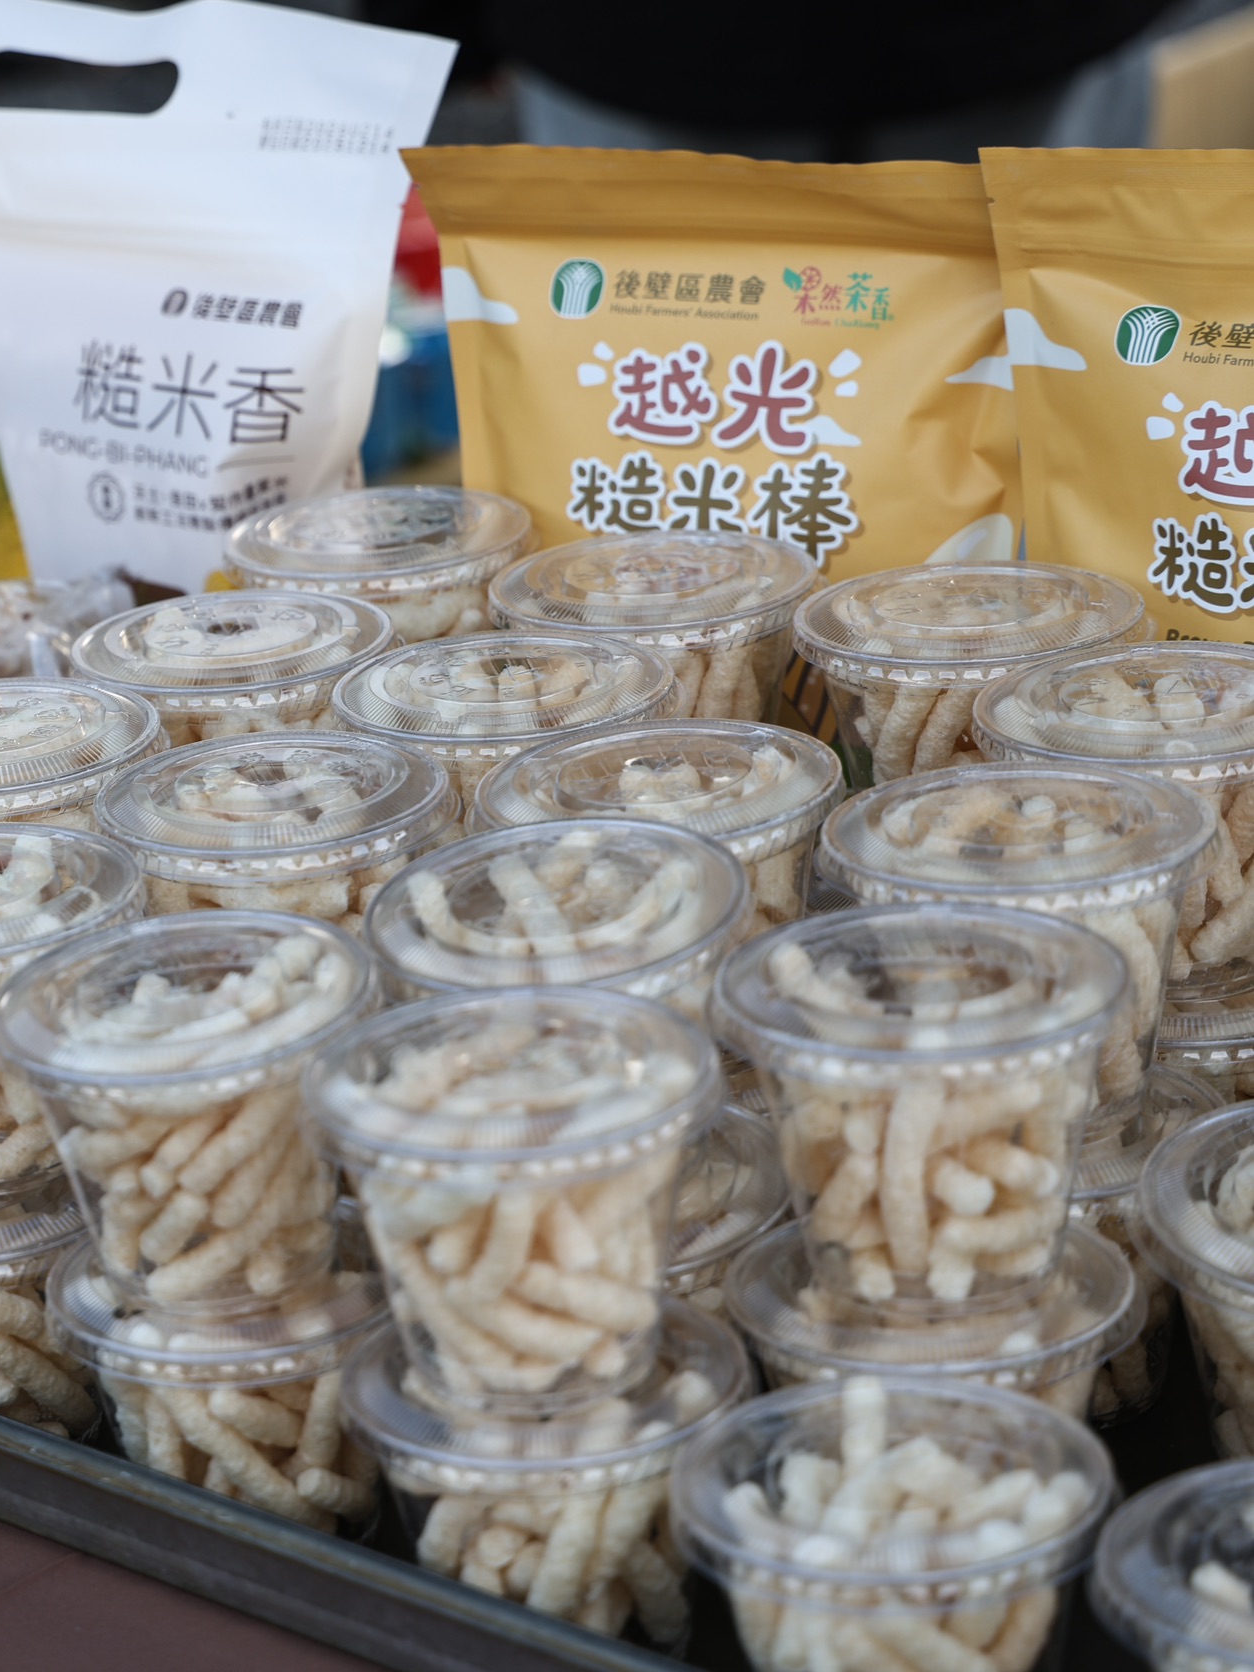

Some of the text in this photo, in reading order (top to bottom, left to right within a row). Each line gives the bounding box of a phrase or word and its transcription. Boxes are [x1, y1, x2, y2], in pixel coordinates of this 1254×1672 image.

[609, 303, 643, 315] Houbi
[695, 308, 759, 321] Association
[612, 268, 767, 305] 後壁區農會
[1183, 351, 1221, 365] Houbi
[1188, 320, 1254, 349] 後壁
[73, 340, 305, 443] 糙米香
[612, 344, 812, 450] 越光
[570, 455, 854, 562] 糙米棒
[1152, 516, 1254, 608] 糙
